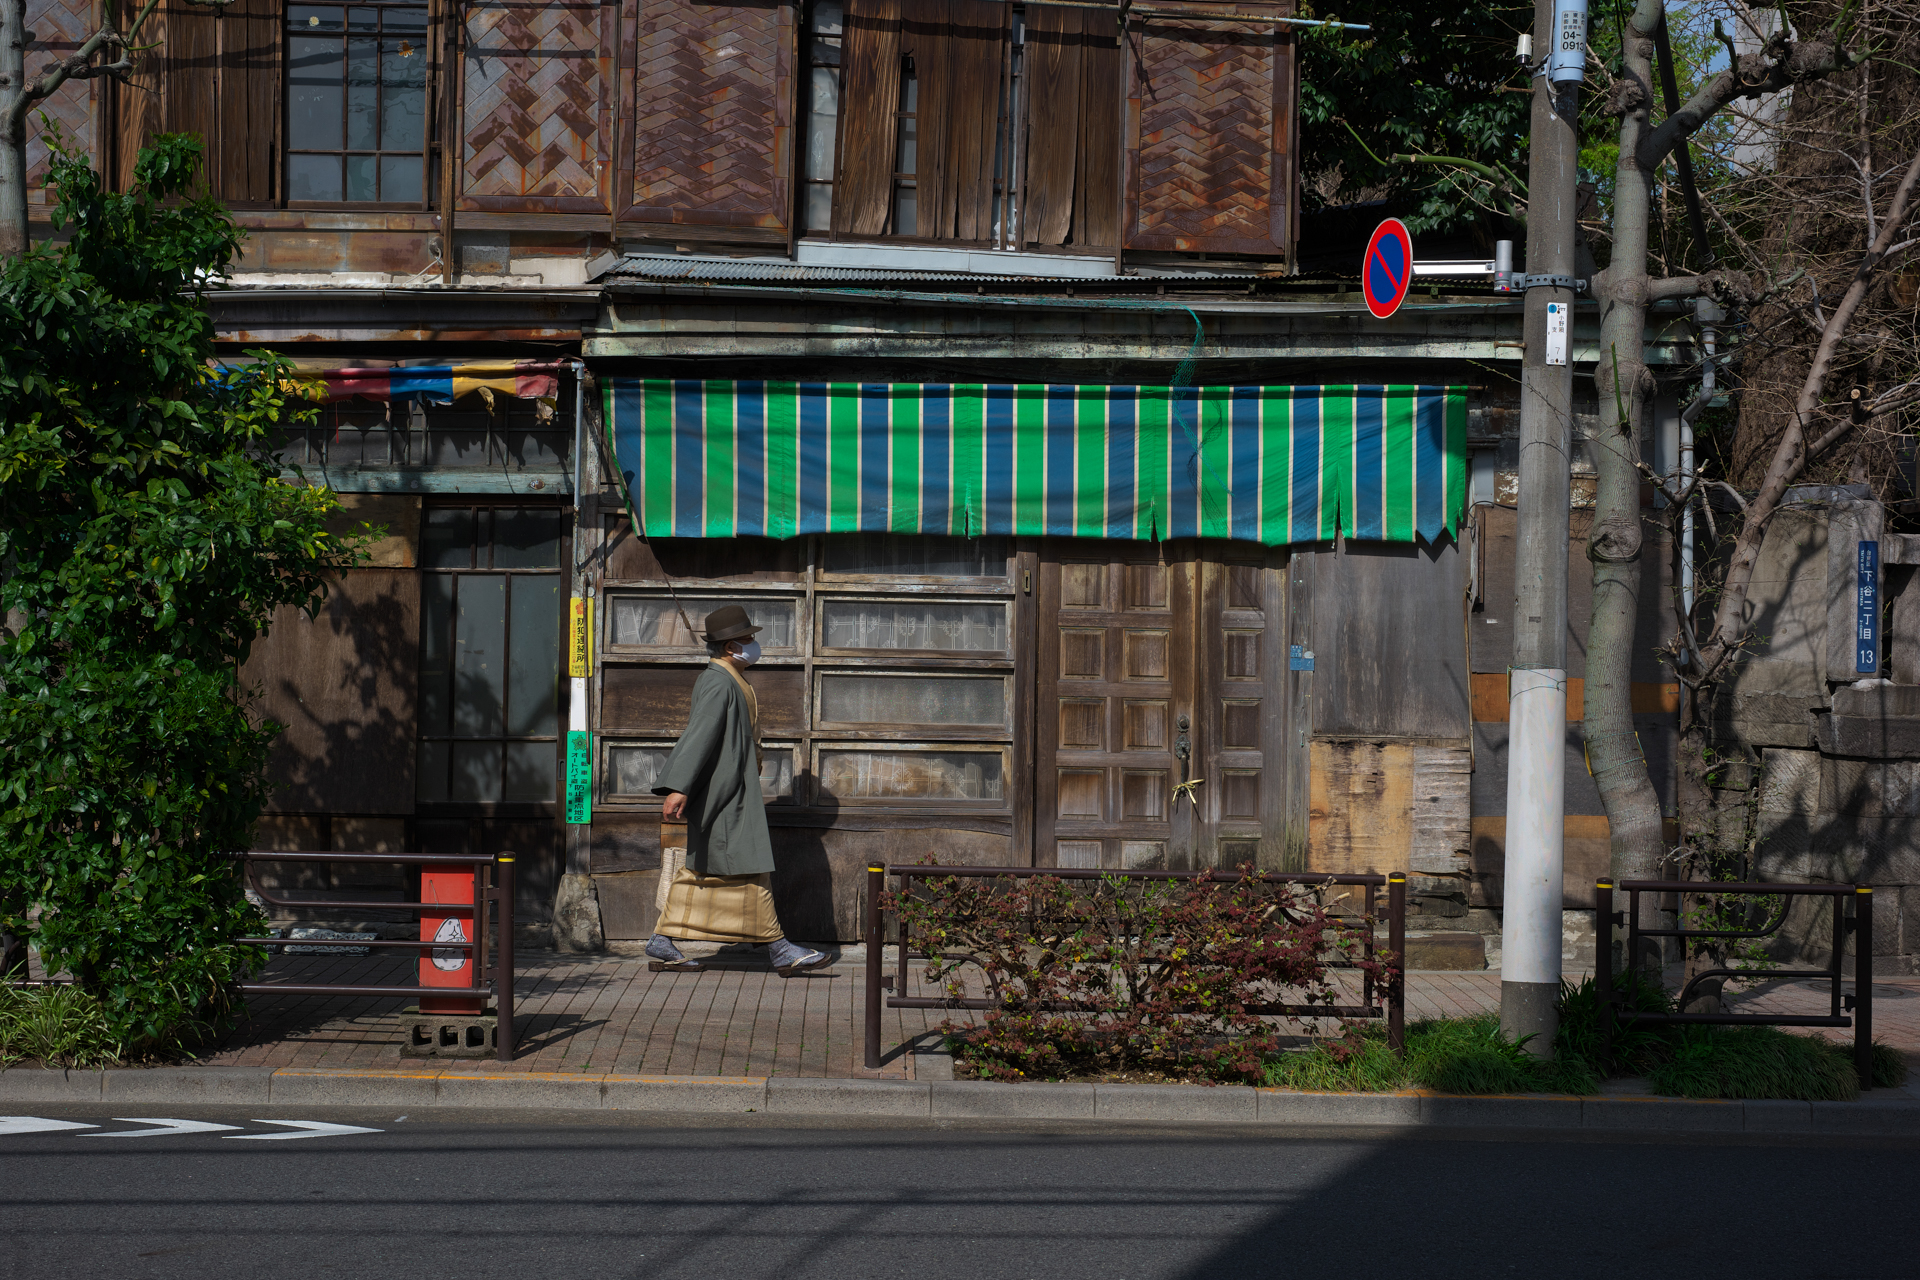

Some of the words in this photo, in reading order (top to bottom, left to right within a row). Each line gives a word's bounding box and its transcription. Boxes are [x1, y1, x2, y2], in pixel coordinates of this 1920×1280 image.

[1563, 31, 1581, 40] 04-
[1562, 41, 1585, 51] 0913
[1863, 570, 1873, 639] 下谷二丁目
[1860, 649, 1873, 664] 13
[574, 784, 584, 821] 防止重点地区
